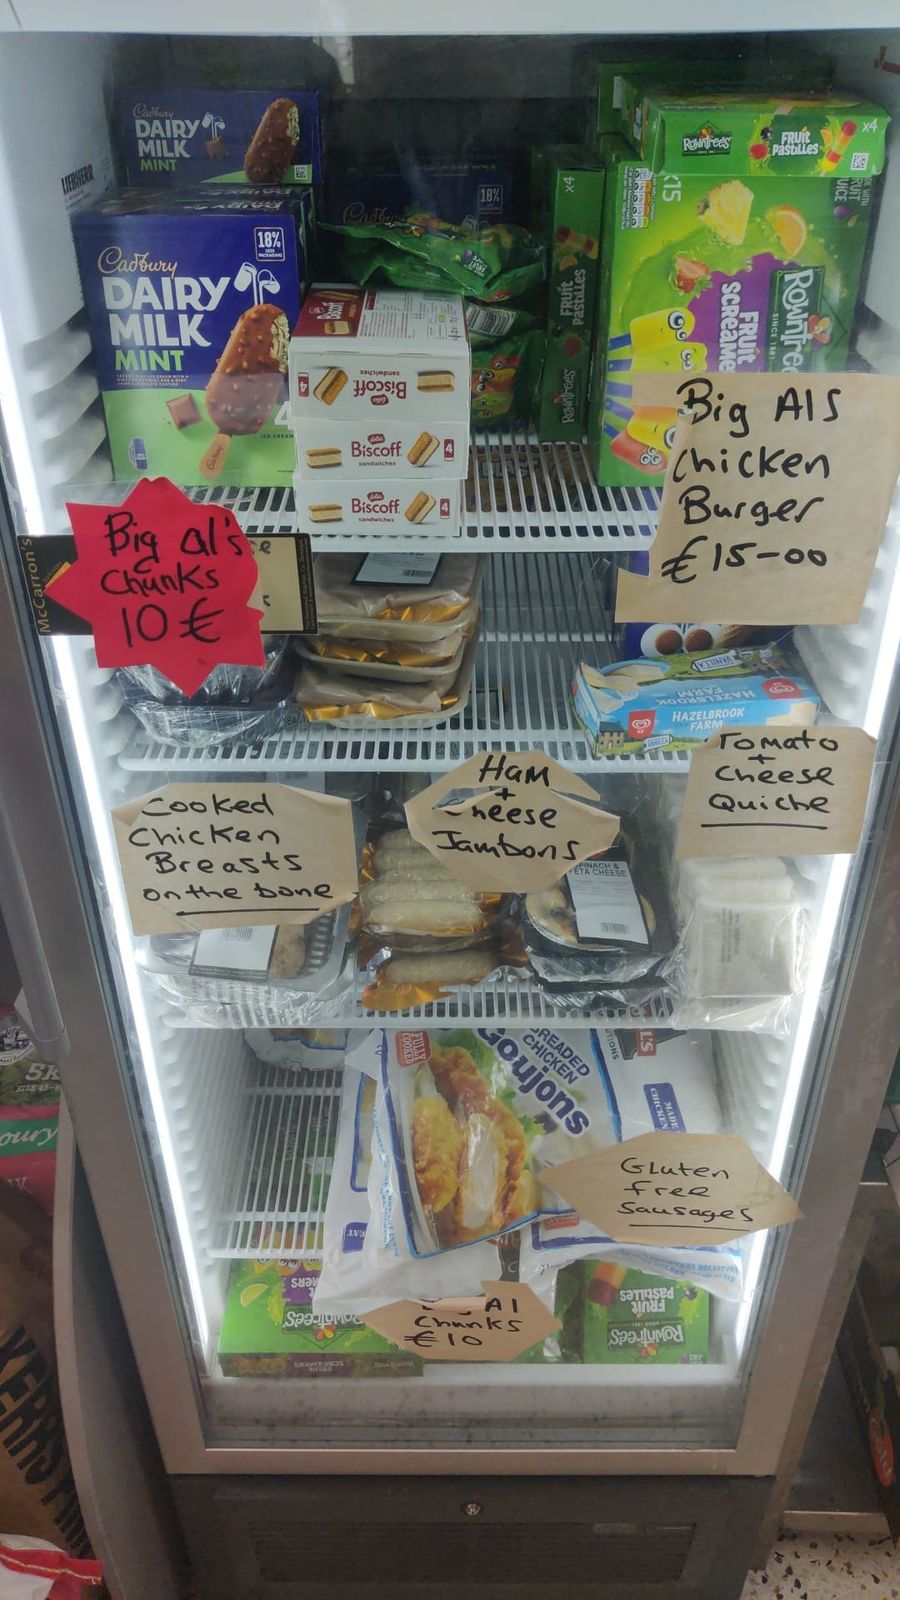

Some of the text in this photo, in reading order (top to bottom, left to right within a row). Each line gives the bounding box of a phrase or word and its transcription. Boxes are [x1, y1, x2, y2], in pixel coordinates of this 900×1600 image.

[132, 103, 175, 119] Cadbury
[134, 119, 200, 138] DAIRY
[863, 120, 878, 133] x4
[138, 139, 191, 159] MILK
[140, 158, 178, 171] MINT
[565, 176, 576, 193] x4
[257, 231, 281, 249] 18%
[98, 246, 178, 278] Cadbury
[102, 276, 231, 311] DAIRY
[108, 314, 212, 347] MILK
[115, 350, 184, 372] MINT
[300, 377, 307, 392] 4
[353, 380, 407, 399] Biscoff
[676, 377, 750, 438] Big
[351, 440, 402, 457] Biscoff
[445, 443, 453, 455] 4
[351, 498, 400, 514] Biscoff
[441, 502, 449, 512] 4
[679, 485, 824, 526] Burger
[104, 511, 159, 574] Big
[20, 536, 50, 633] McCarron's
[121, 597, 225, 648] 10 €
[699, 652, 735, 672] VANILLA
[656, 690, 756, 706] HAZELBROOK
[677, 685, 722, 698] FARM
[672, 707, 746, 722] HAZELBROOK
[689, 719, 723, 732] FARM
[704, 730, 839, 750] Tomato
[748, 754, 776, 765] +
[715, 765, 835, 786] Cheese
[494, 787, 516, 800] +
[708, 793, 830, 814] Quiche
[141, 793, 275, 816] Cooked
[128, 824, 280, 847] Chicken
[145, 851, 302, 874] Breasts
[592, 868, 628, 877] CHEESE
[253, 882, 334, 899] bone
[412, 1031, 426, 1061] FULLY
[529, 1028, 590, 1077] READED
[522, 1034, 579, 1085] CHICKEN
[477, 1027, 590, 1135] Goujons
[650, 1087, 669, 1131] CHICKEN
[665, 1101, 680, 1130] MADE
[620, 1157, 729, 1180] Gluten
[414, 1316, 522, 1333] Chunks
